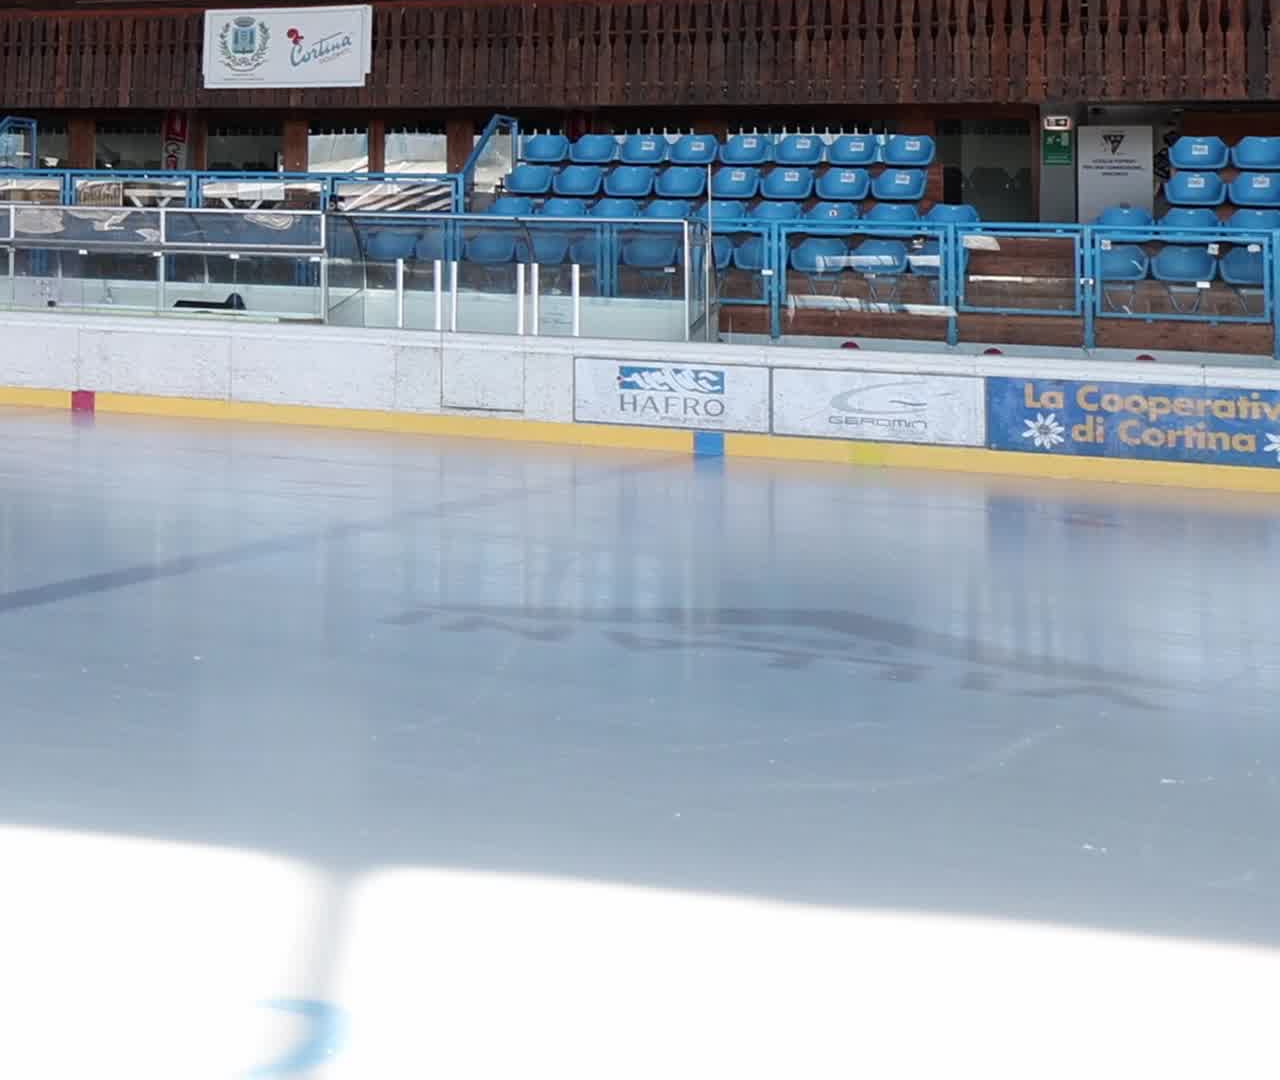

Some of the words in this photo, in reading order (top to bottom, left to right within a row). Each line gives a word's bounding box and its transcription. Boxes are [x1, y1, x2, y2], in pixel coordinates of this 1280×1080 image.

[290, 32, 352, 67] Cortina
[620, 394, 724, 417] HAFRO
[1024, 383, 1064, 409] La
[1072, 416, 1104, 444] di
[1118, 419, 1256, 452] Cortina
